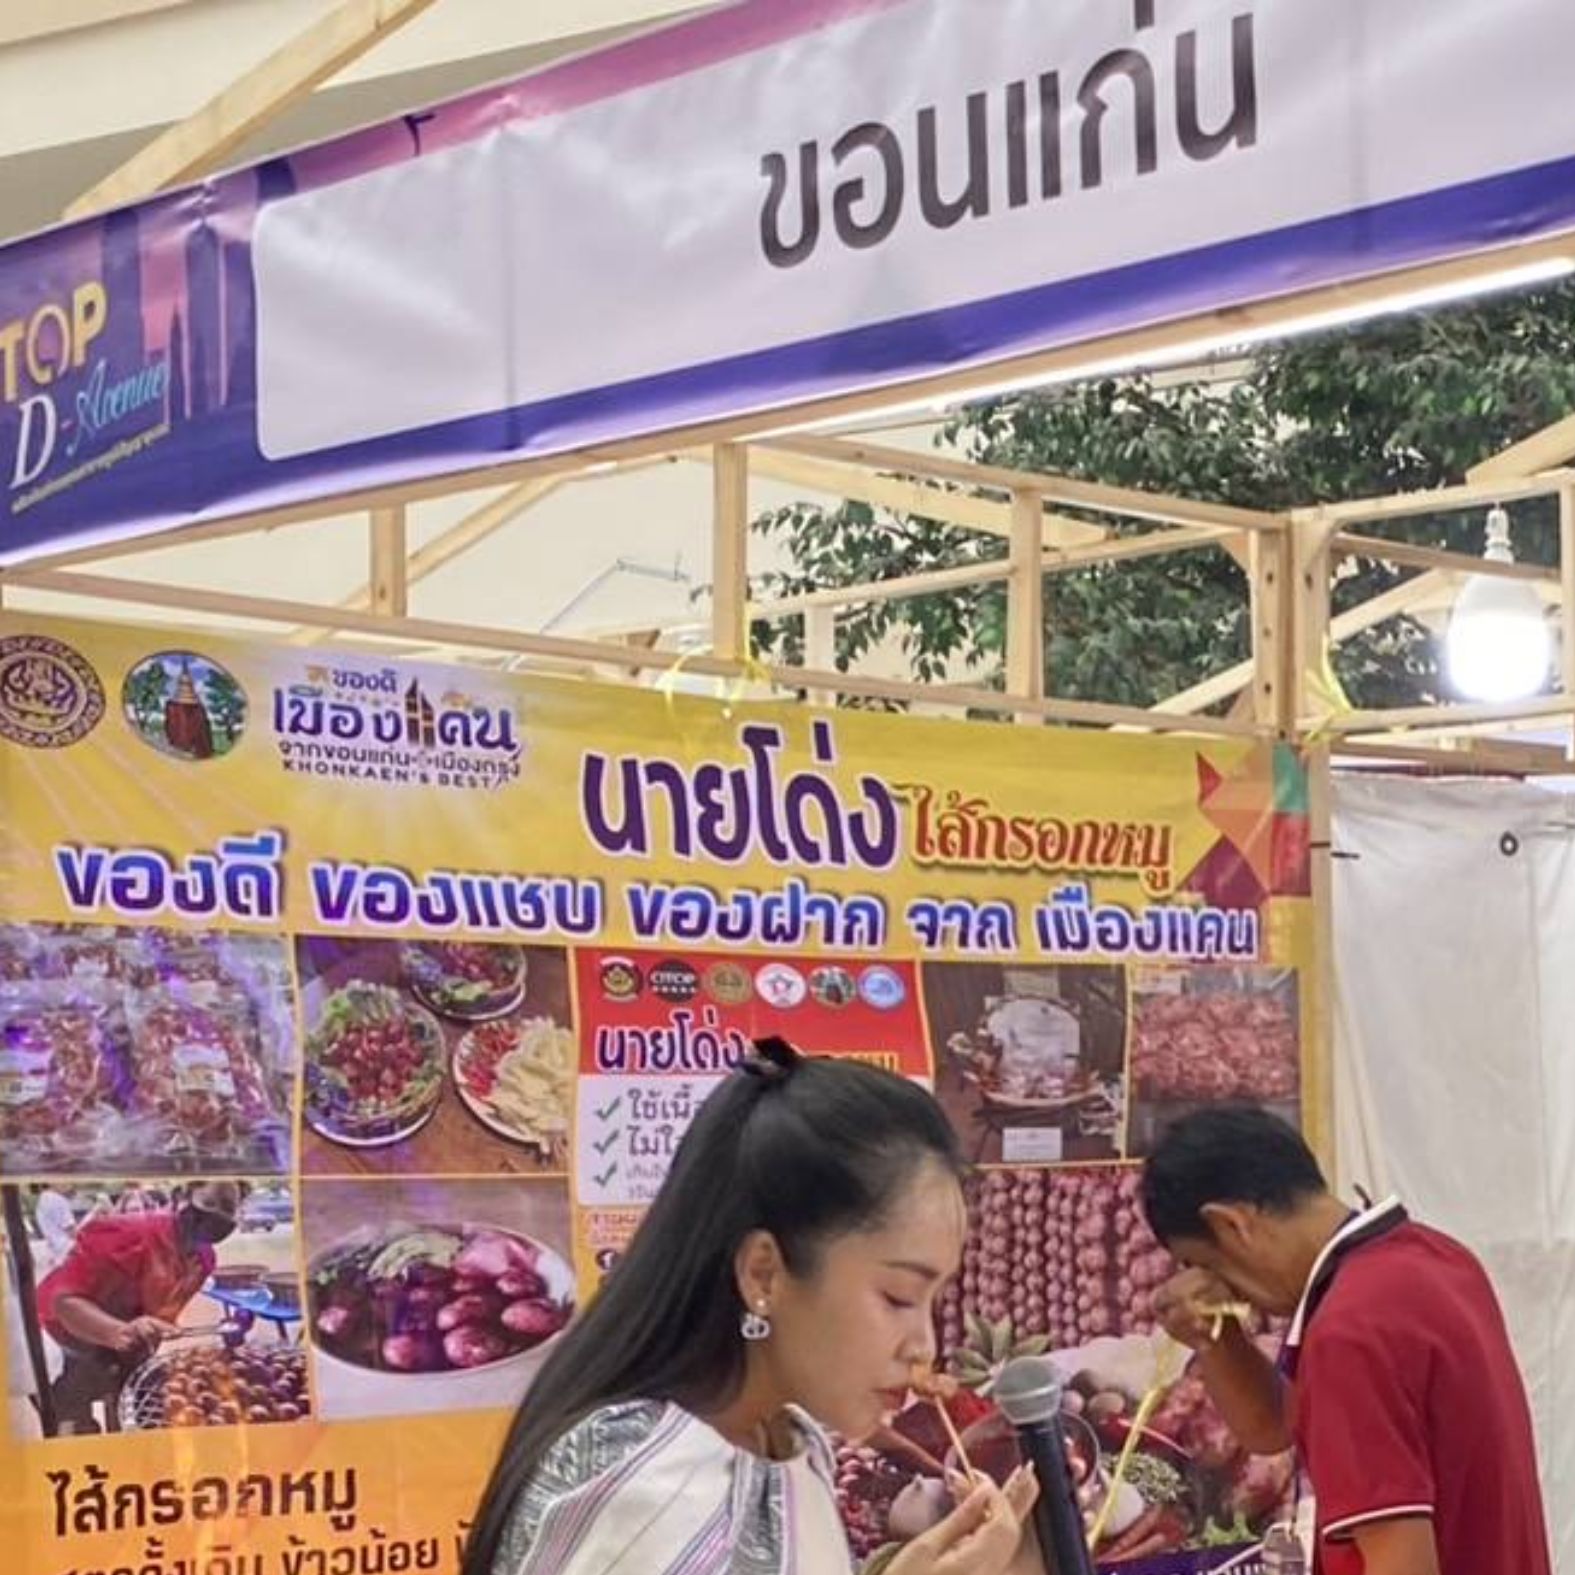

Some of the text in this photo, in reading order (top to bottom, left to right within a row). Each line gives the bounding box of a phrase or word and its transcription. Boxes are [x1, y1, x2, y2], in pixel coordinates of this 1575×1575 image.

[760, 0, 1257, 268] ขอนแก่น
[581, 722, 1173, 892] นายโด่ง ไส้กรอกหมู
[57, 829, 281, 918] ของดี
[629, 880, 883, 949] ของฝาก
[908, 899, 1015, 952] จาก
[1036, 879, 1258, 957] เมืองแคน
[599, 1009, 747, 1071] นายโด่ง
[47, 1466, 357, 1536] ไส้กรอกหมู
